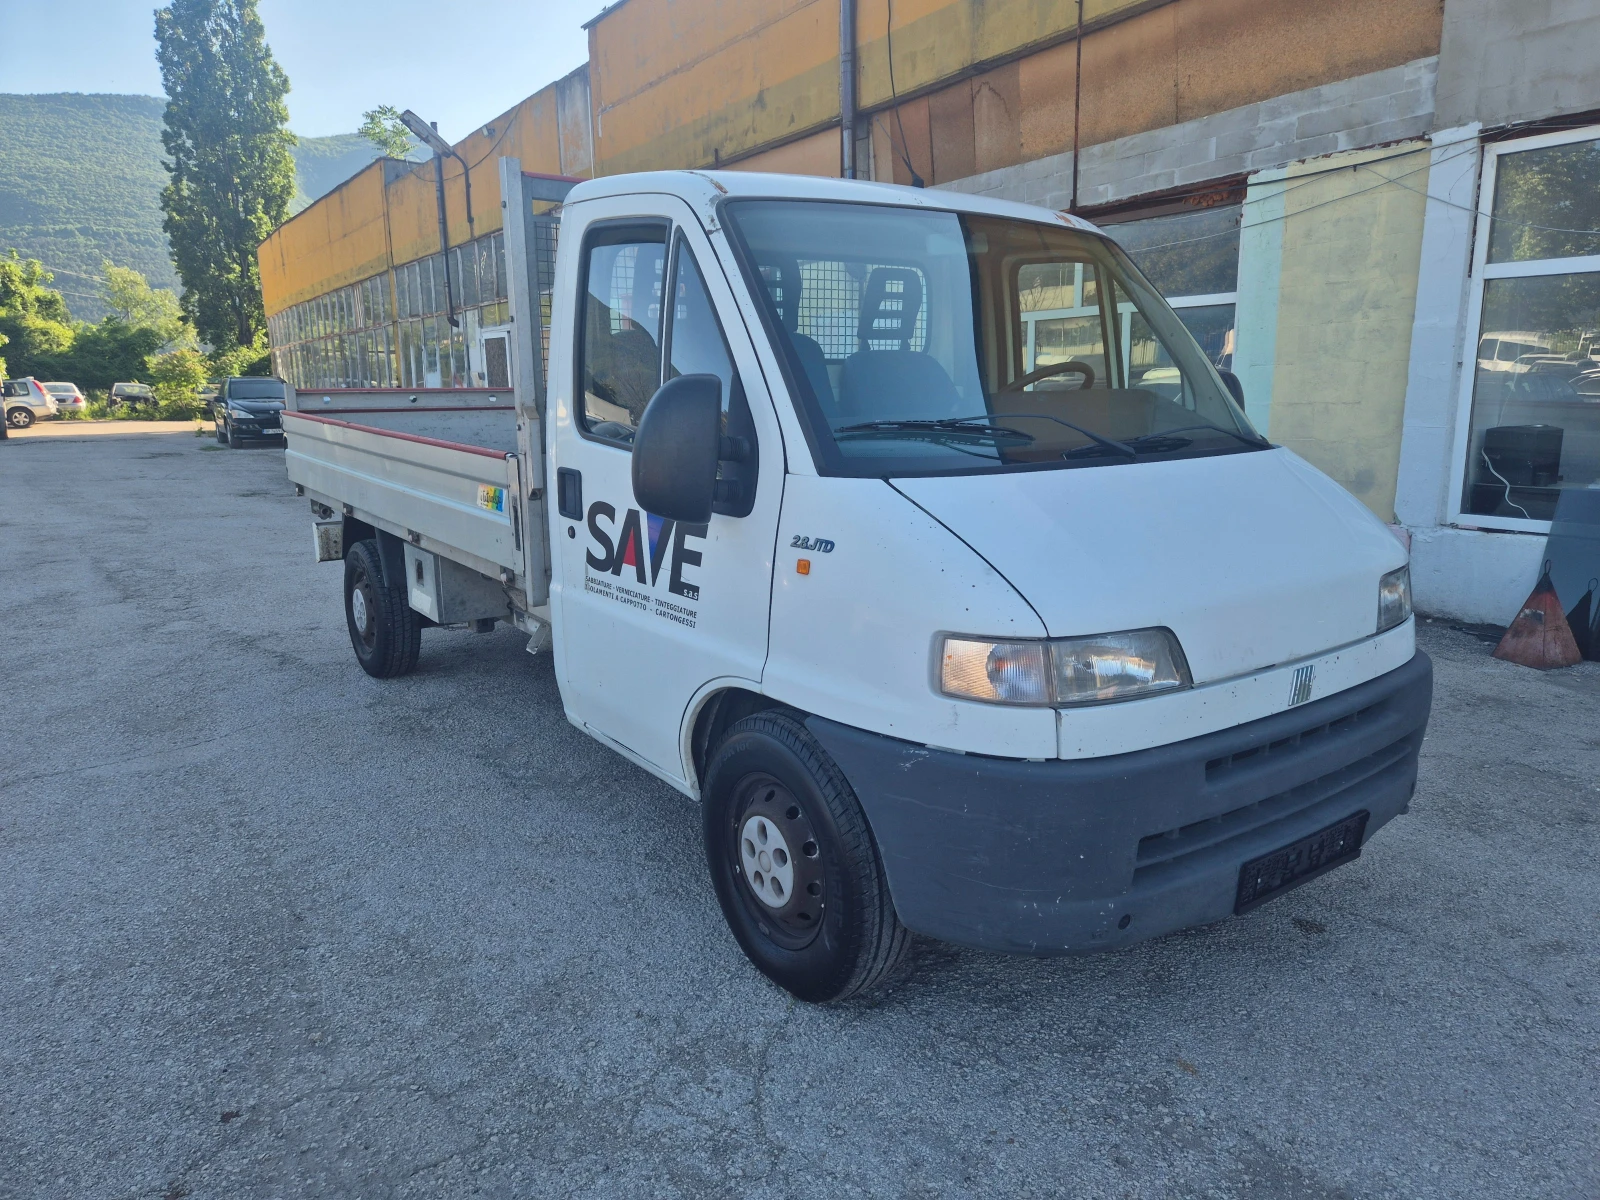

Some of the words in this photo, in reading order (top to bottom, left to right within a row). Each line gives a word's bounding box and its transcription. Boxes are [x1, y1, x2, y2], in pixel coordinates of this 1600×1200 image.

[586, 500, 709, 599] SAVE
[615, 585, 651, 603] VERNICIATURE
[654, 598, 698, 619] TINTEGGIATURE
[619, 596, 647, 611] CAPPOTTO
[655, 608, 697, 629] CARTONGESSI
